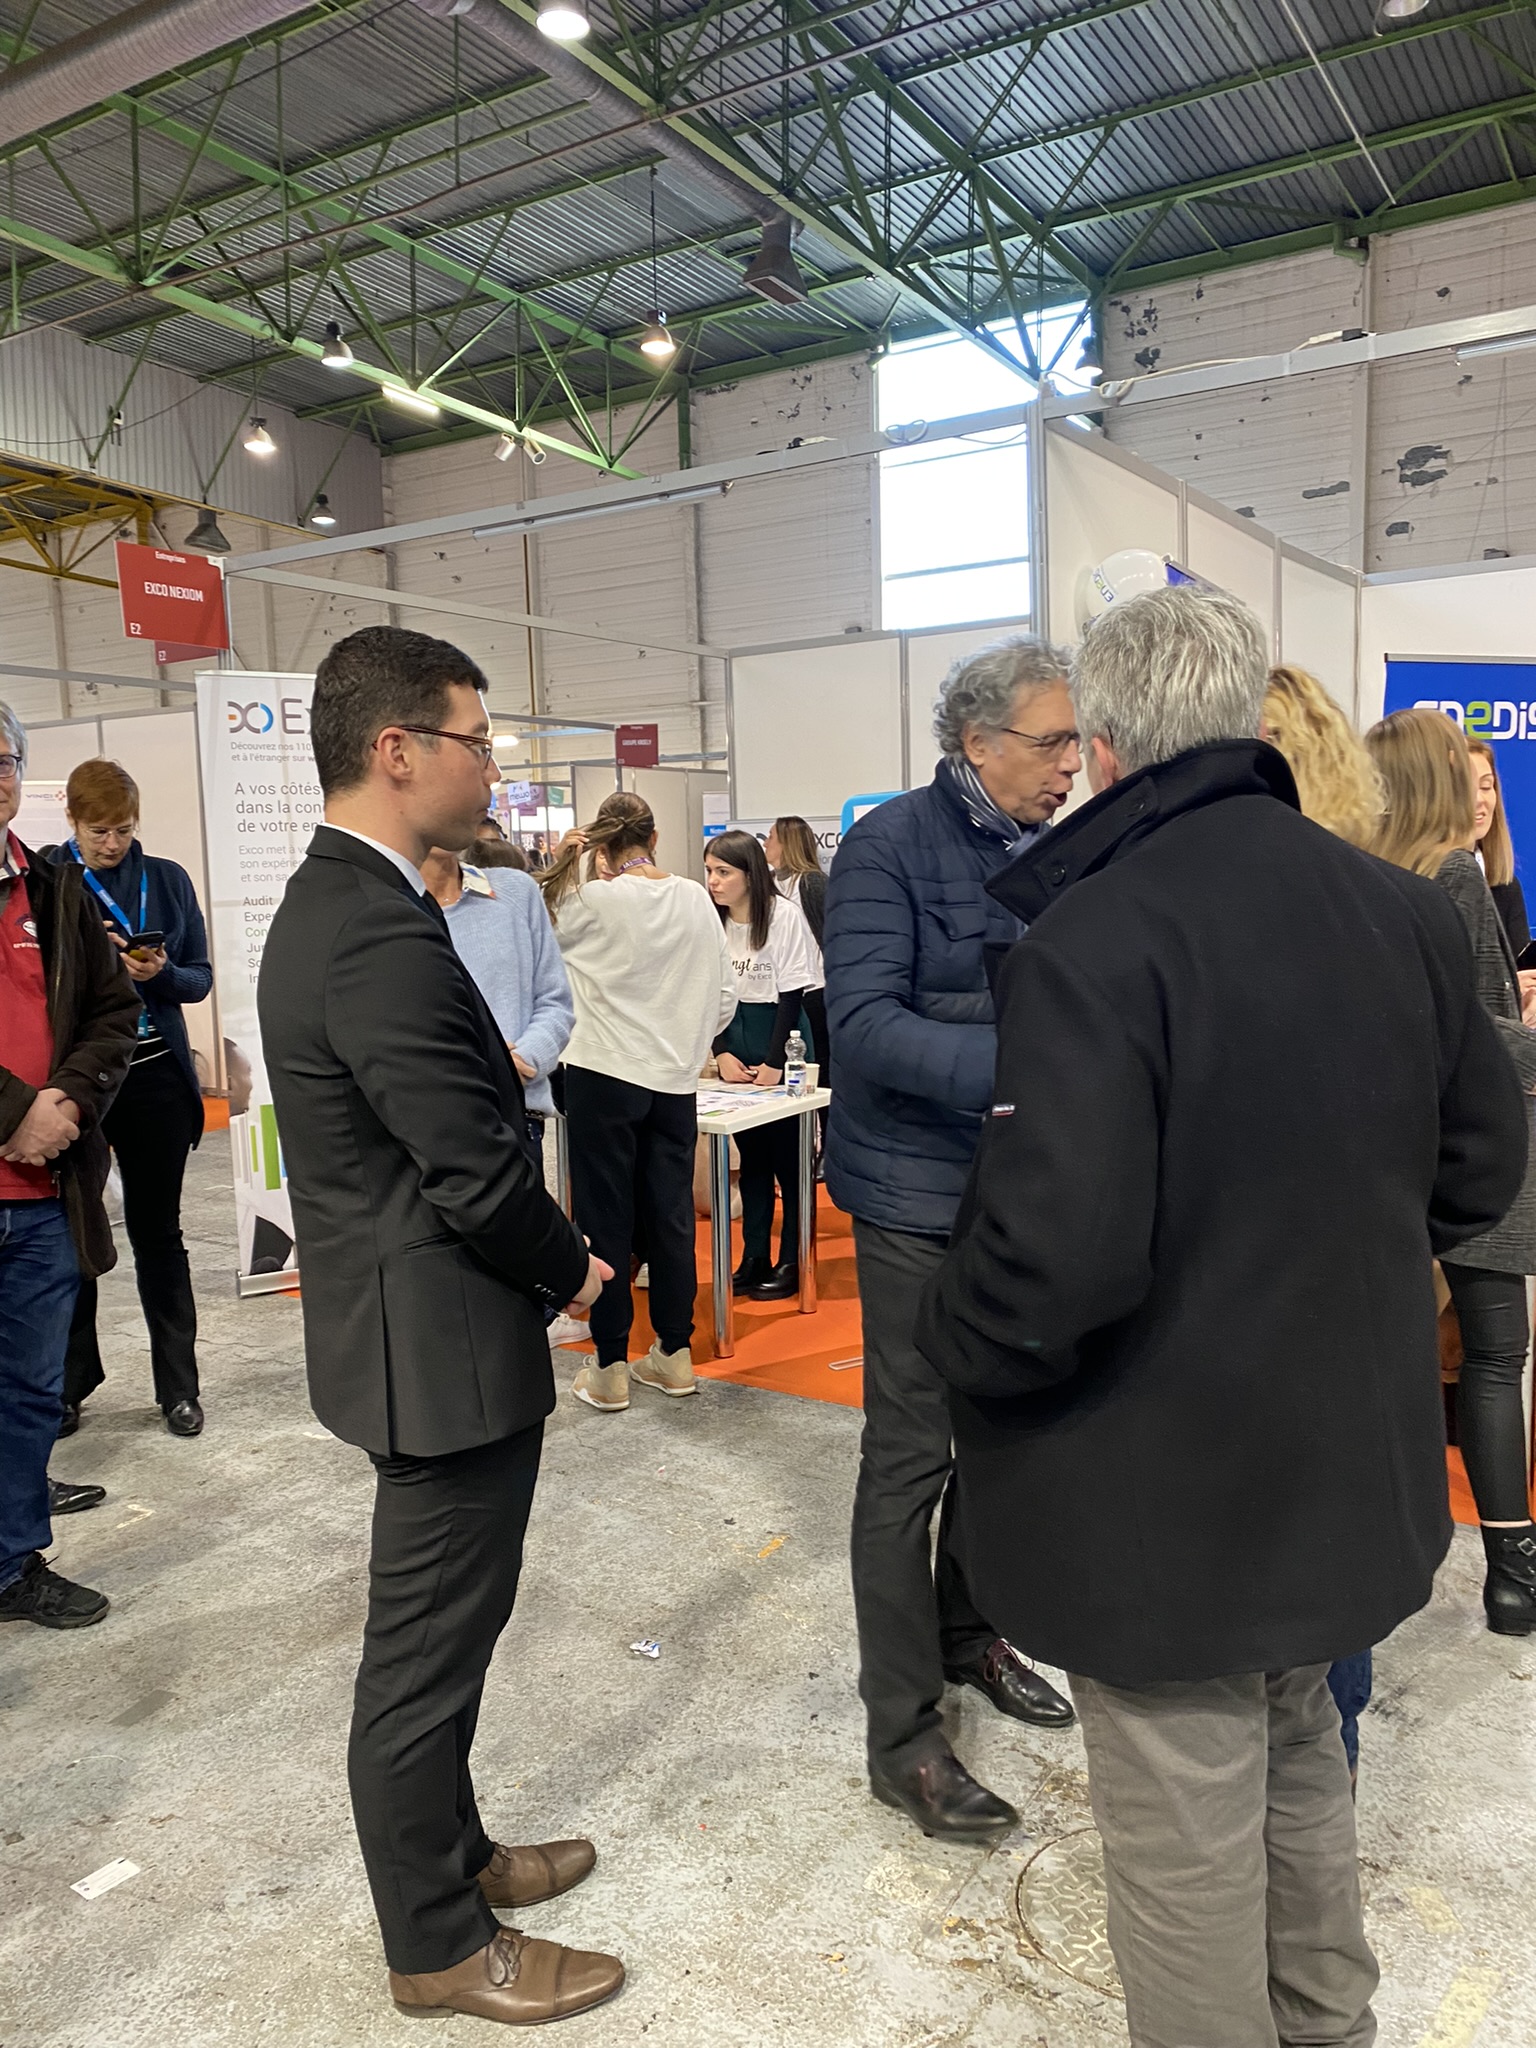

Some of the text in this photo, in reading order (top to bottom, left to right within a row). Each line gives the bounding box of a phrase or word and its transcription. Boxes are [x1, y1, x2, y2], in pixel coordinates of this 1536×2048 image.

[144, 581, 204, 602] EXCO NEXIOM
[130, 622, 142, 635] E2
[281, 698, 311, 734] E
[230, 741, 276, 751] Découvrez
[242, 753, 248, 761] à
[249, 753, 290, 764] l'étranger
[234, 781, 321, 795] A vos côtés
[235, 800, 273, 814] dans
[278, 800, 291, 814] la
[237, 819, 256, 832] de
[260, 820, 299, 832] votre
[238, 845, 264, 855] Exco
[266, 845, 287, 854] met
[289, 844, 296, 854] à
[240, 858, 300, 870] son expérie
[241, 873, 289, 882] et son sa
[243, 895, 274, 906] Audit
[752, 962, 772, 972] ans
